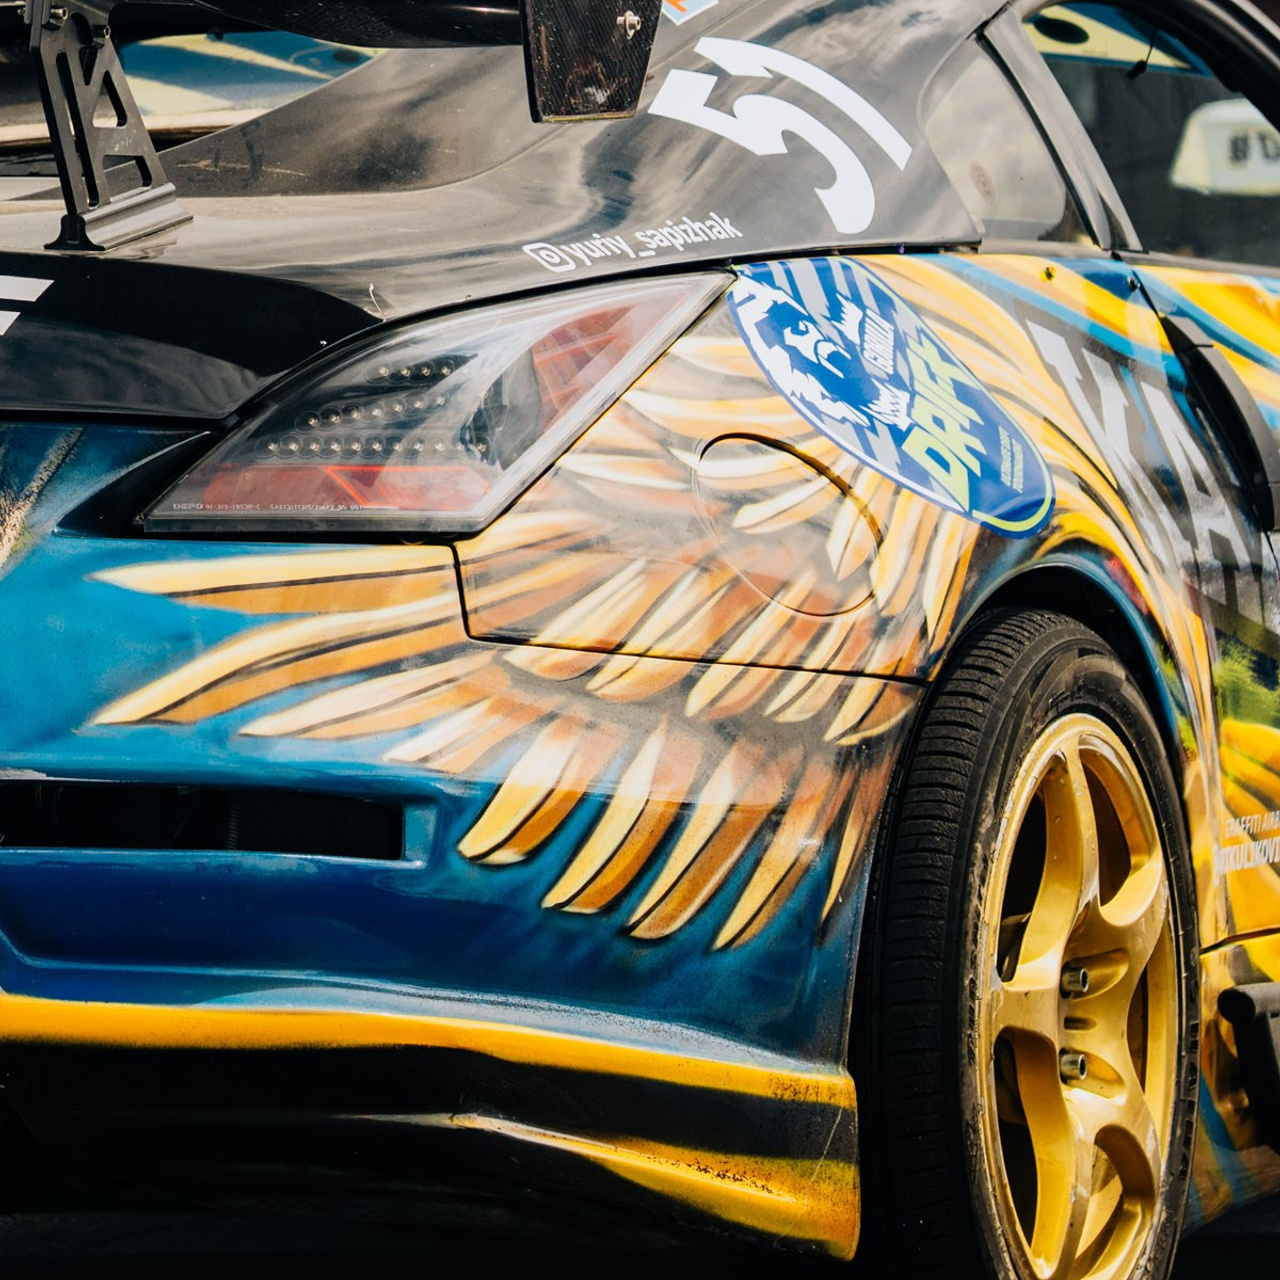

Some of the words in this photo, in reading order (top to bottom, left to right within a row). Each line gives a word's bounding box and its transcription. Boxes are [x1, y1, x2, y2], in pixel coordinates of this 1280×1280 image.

[648, 36, 913, 235] 51
[863, 307, 895, 375] GORILLA
[901, 331, 984, 513] DRIFT
